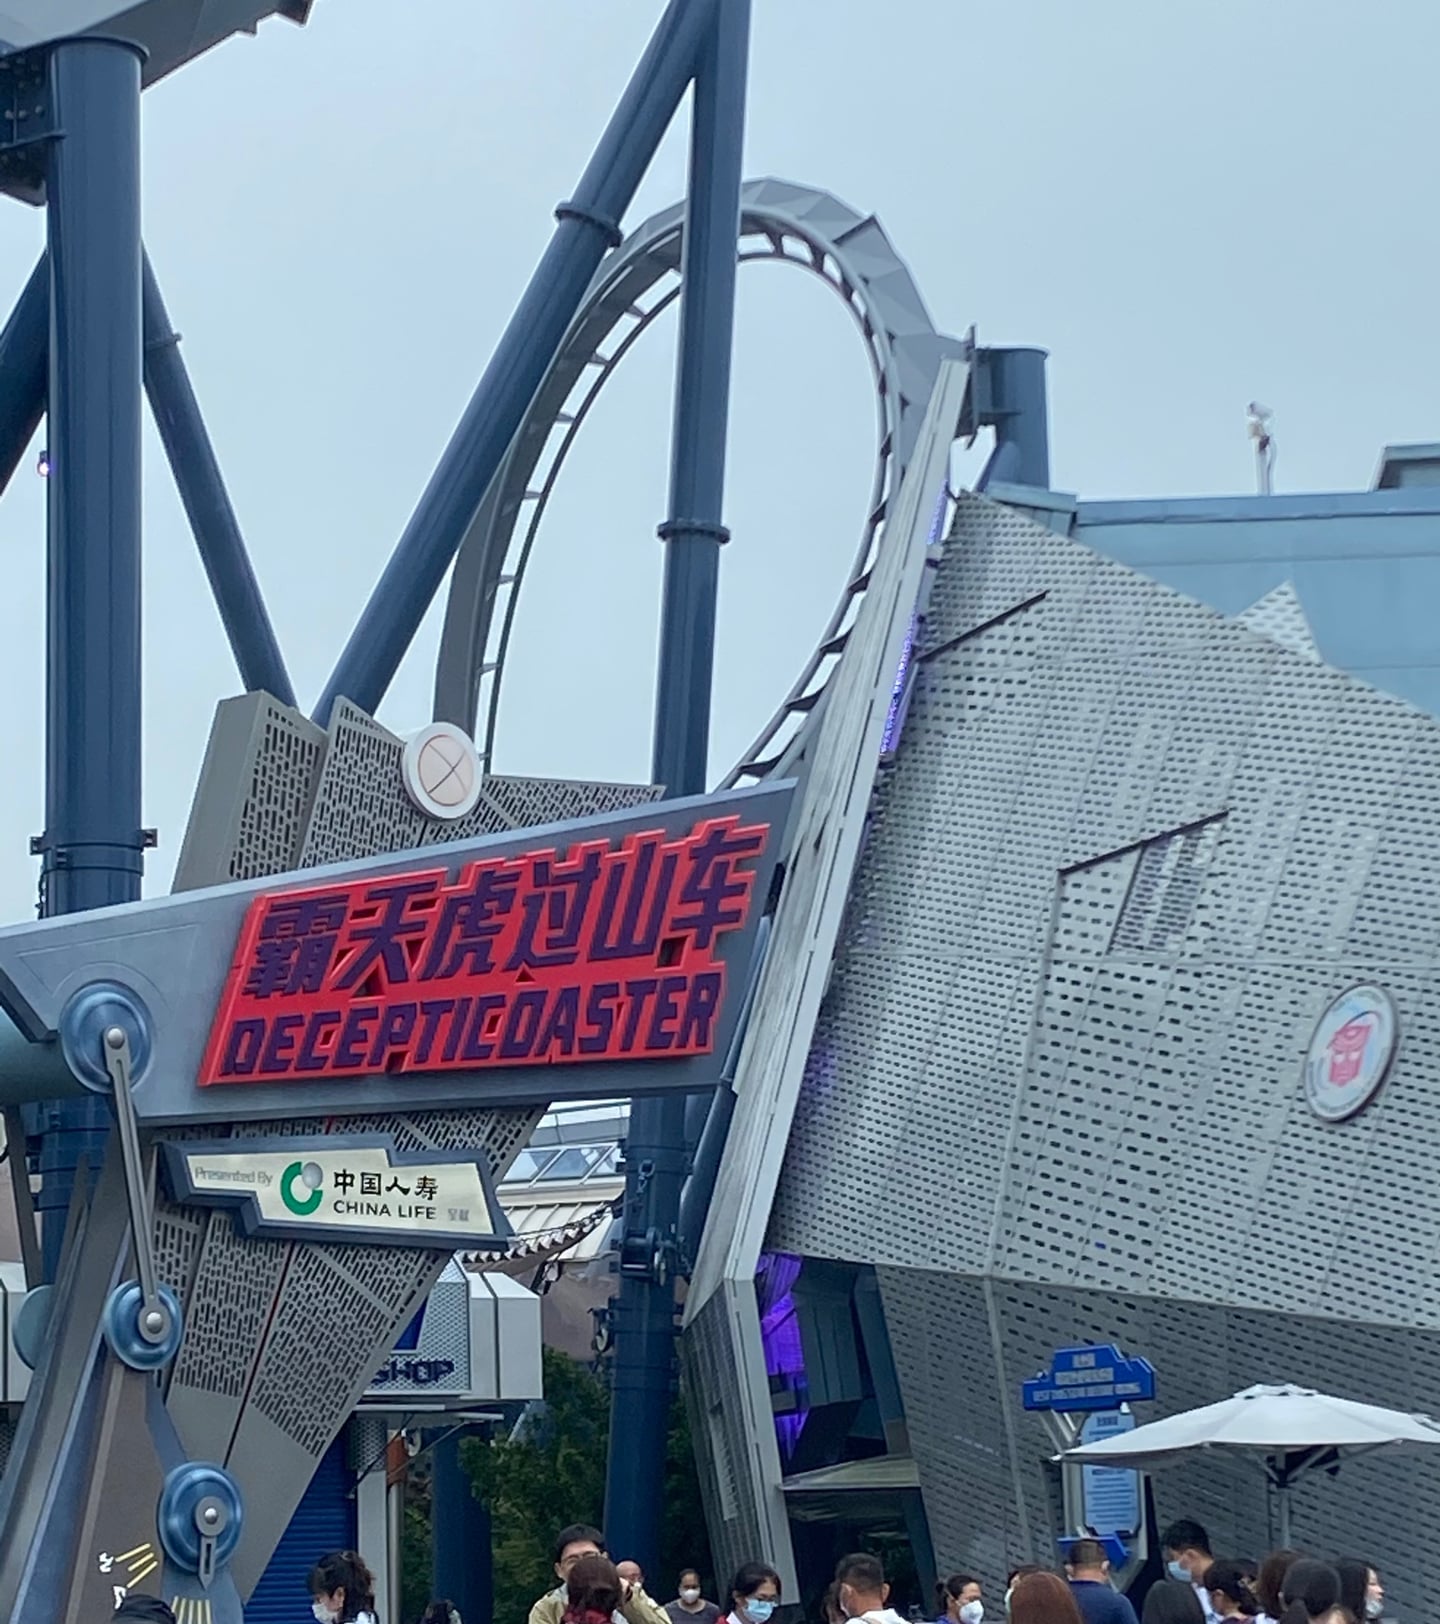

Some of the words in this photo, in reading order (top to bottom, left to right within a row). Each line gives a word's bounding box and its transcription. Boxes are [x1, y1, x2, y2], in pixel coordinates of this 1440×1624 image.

[242, 828, 762, 1000] 霸天虎过山车
[219, 972, 722, 1076] DECEPTICOASTER
[194, 1166, 256, 1184] Presented
[257, 1170, 274, 1187] By
[333, 1168, 439, 1201] 中国人寿
[333, 1200, 392, 1217] CHINA
[398, 1205, 437, 1220] LIFE
